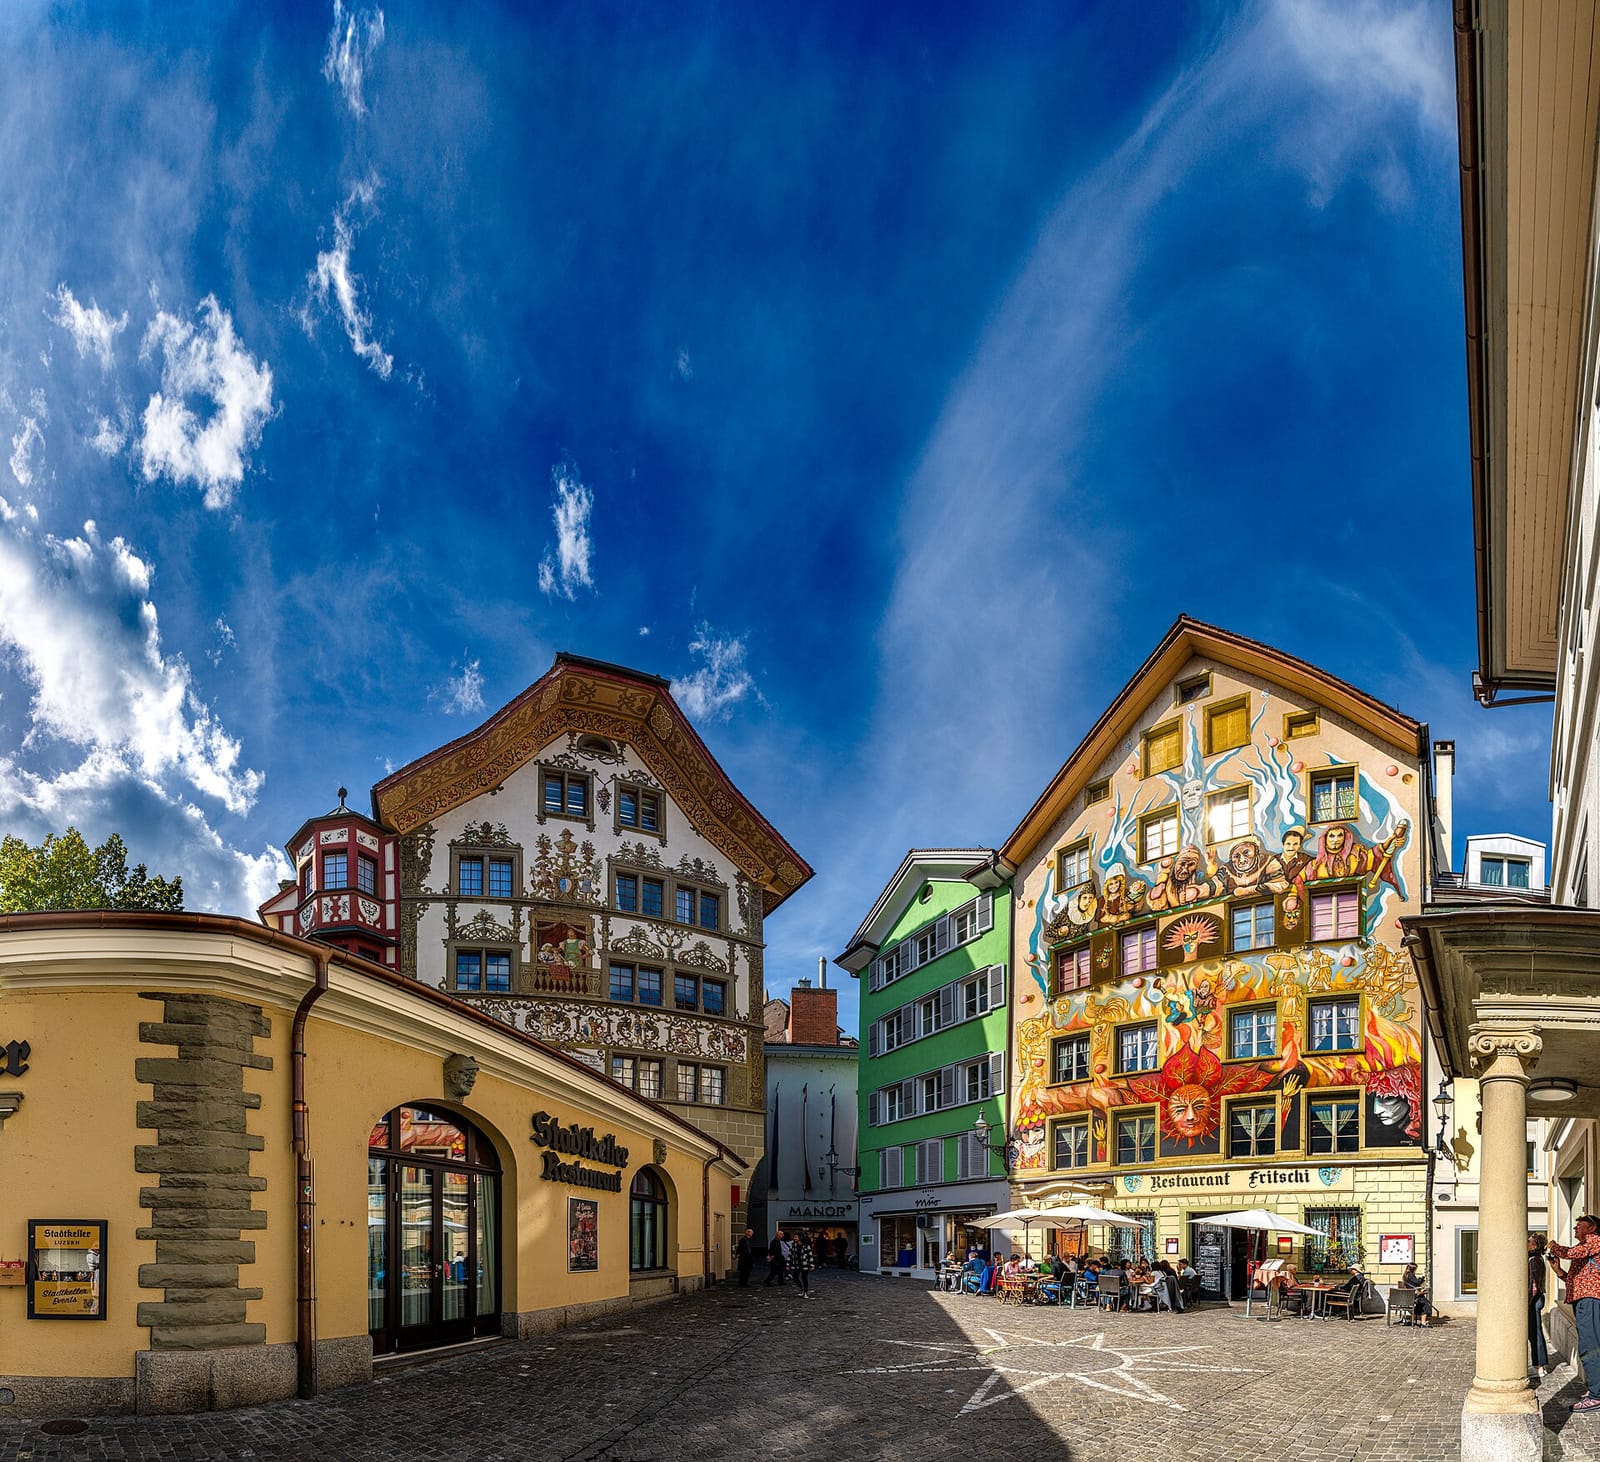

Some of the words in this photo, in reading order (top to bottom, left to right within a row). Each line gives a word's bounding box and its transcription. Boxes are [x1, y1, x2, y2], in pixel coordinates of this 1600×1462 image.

[530, 1110, 629, 1168] Stadtkeller
[540, 1150, 622, 1193] Restaurant
[1150, 1173, 1231, 1192] Restaurant
[1248, 1169, 1311, 1189] Fritschi
[44, 1229, 91, 1238] Stadtkeller
[42, 1287, 88, 1298] Stadtkeller
[52, 1297, 77, 1305] Events
